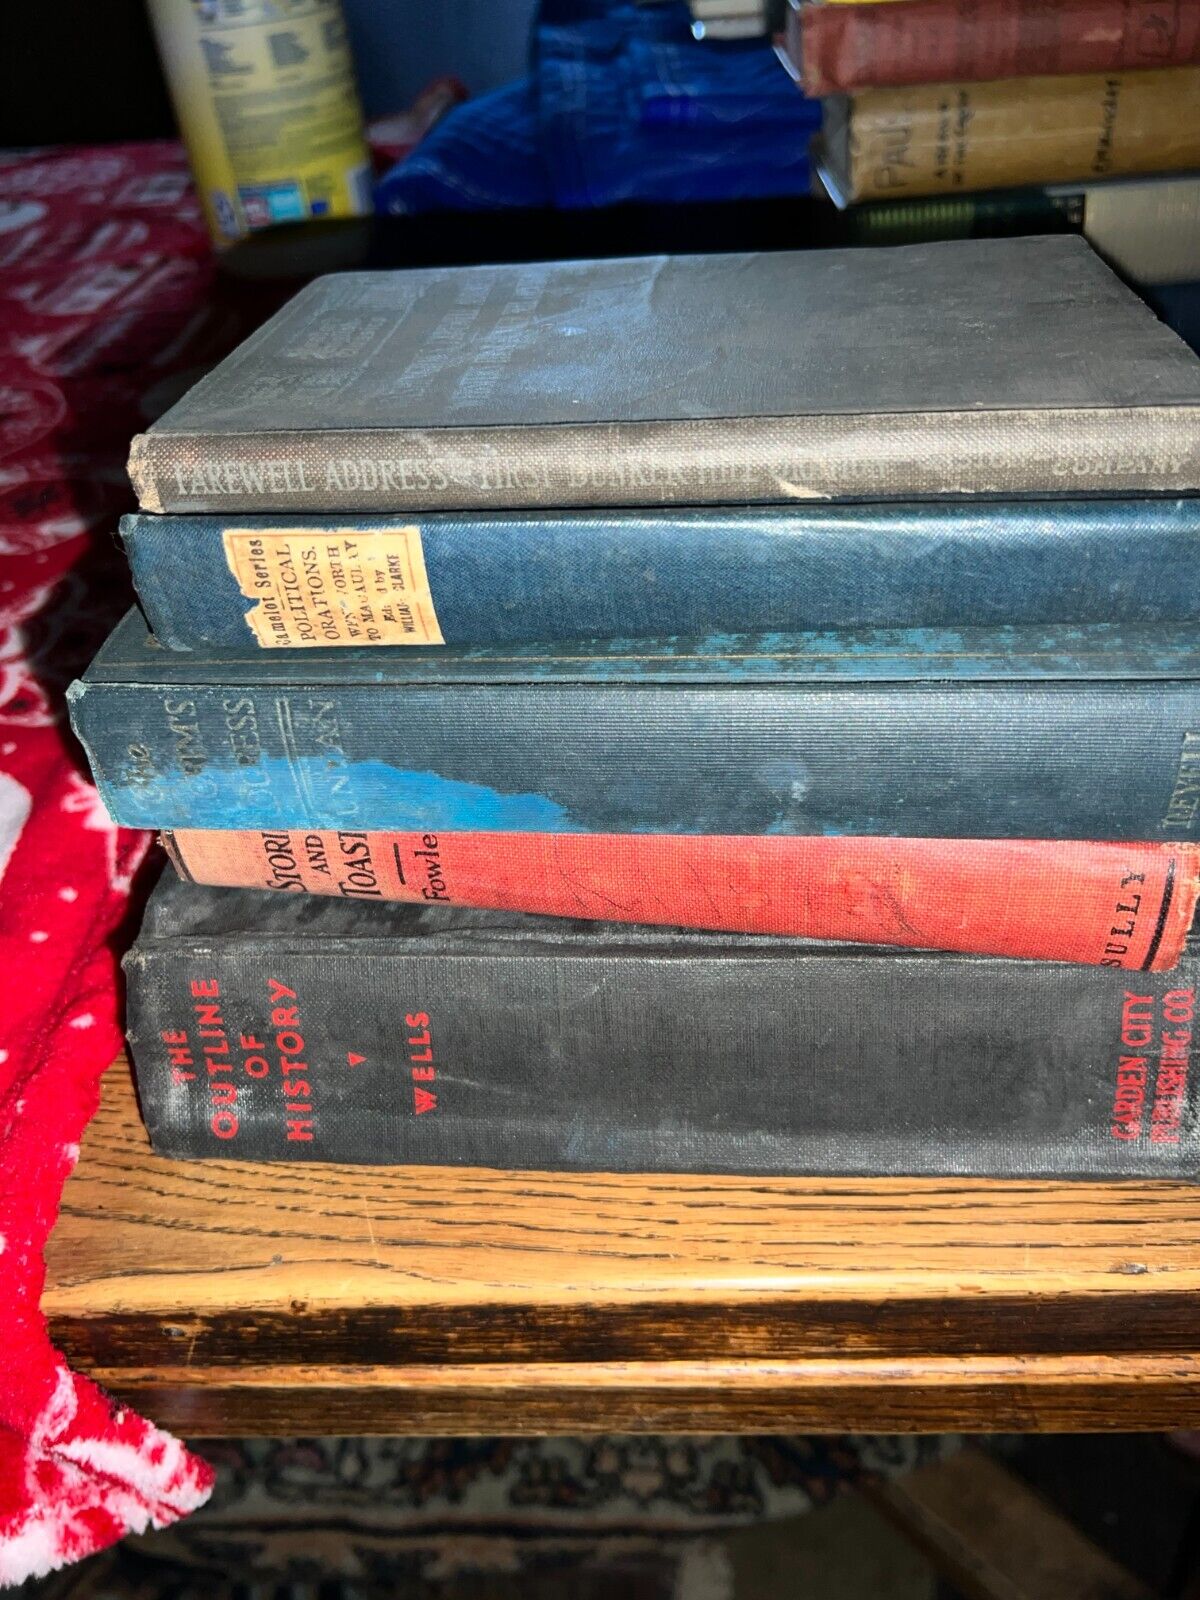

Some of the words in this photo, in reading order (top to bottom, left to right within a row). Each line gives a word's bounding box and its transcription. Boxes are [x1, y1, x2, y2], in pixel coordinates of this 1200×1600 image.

[173, 460, 316, 495] FAREWELL
[325, 458, 449, 492] ADDRESS
[249, 539, 272, 589] Series
[276, 543, 317, 642] POLITICAL
[302, 545, 341, 640] ORATIONS.
[374, 569, 387, 586] by
[367, 627, 382, 641] TO
[305, 834, 331, 876] AND
[1100, 871, 1146, 969] SULLY
[1120, 989, 1153, 1048] CITY
[160, 1028, 197, 1087] THE
[191, 978, 240, 1140] OUTLINE
[240, 1032, 270, 1080] OF
[267, 977, 315, 1143] HISTORY
[405, 1010, 438, 1116] WELLS
[1111, 1055, 1148, 1141] GARDEN
